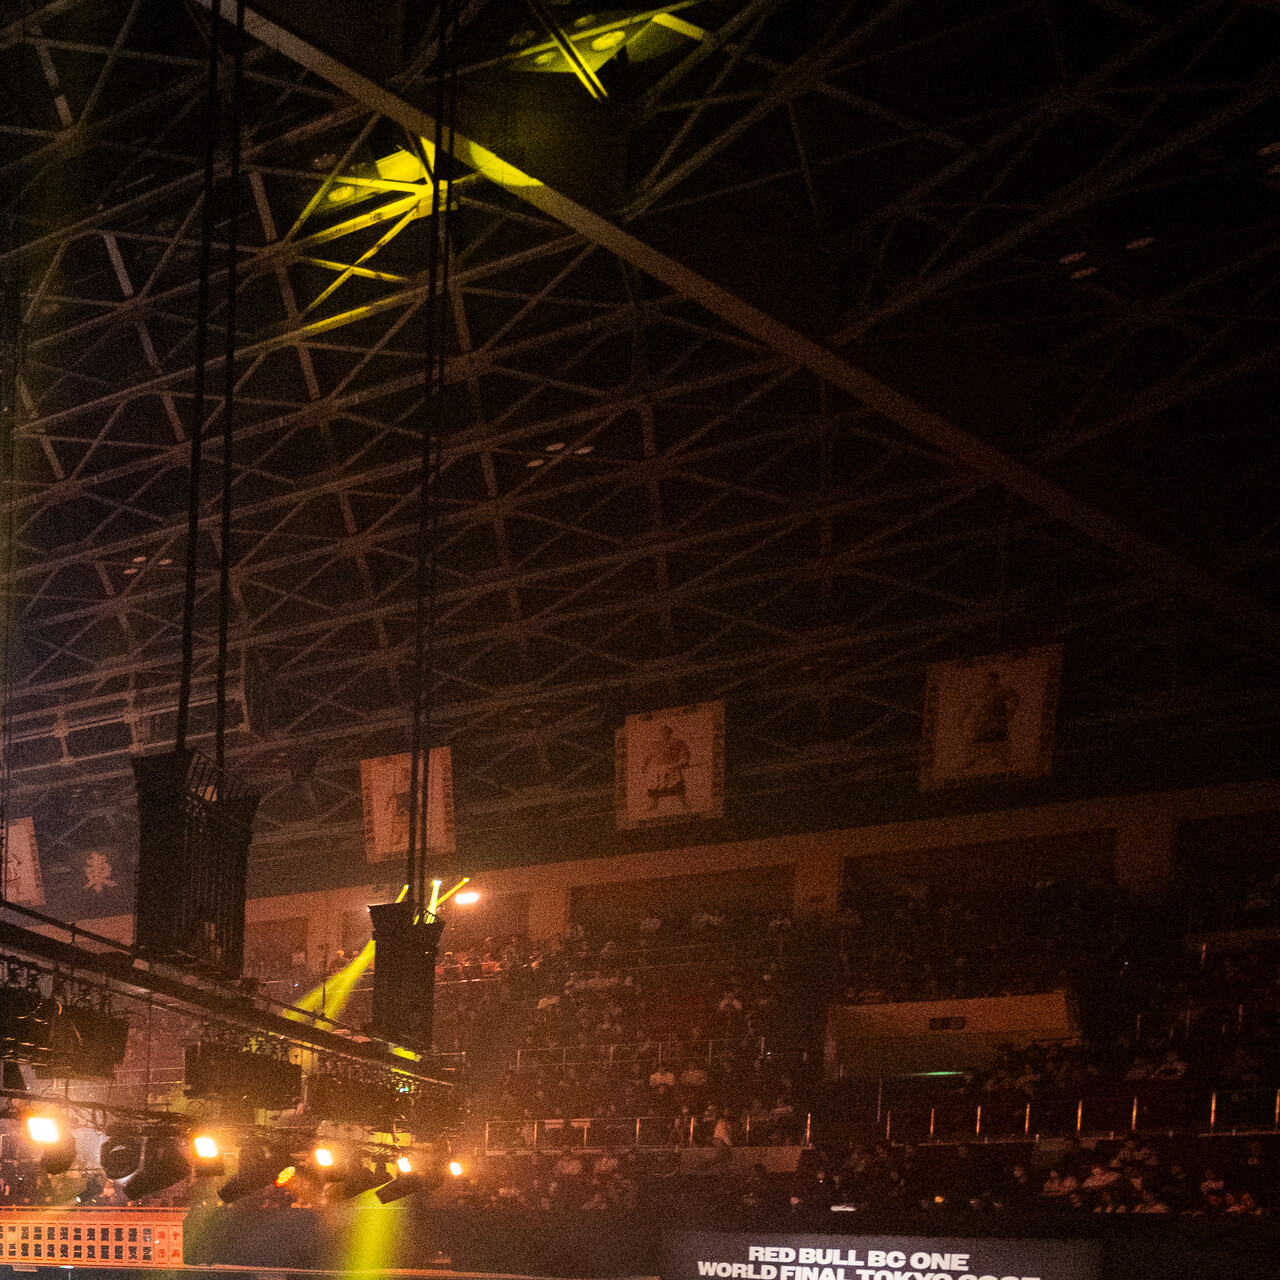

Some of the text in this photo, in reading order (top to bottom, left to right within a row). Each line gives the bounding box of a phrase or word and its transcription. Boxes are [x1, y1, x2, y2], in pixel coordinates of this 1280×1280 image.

[748, 1246, 970, 1271] RED BULL BC ONE
[697, 1261, 777, 1280] WORLD
